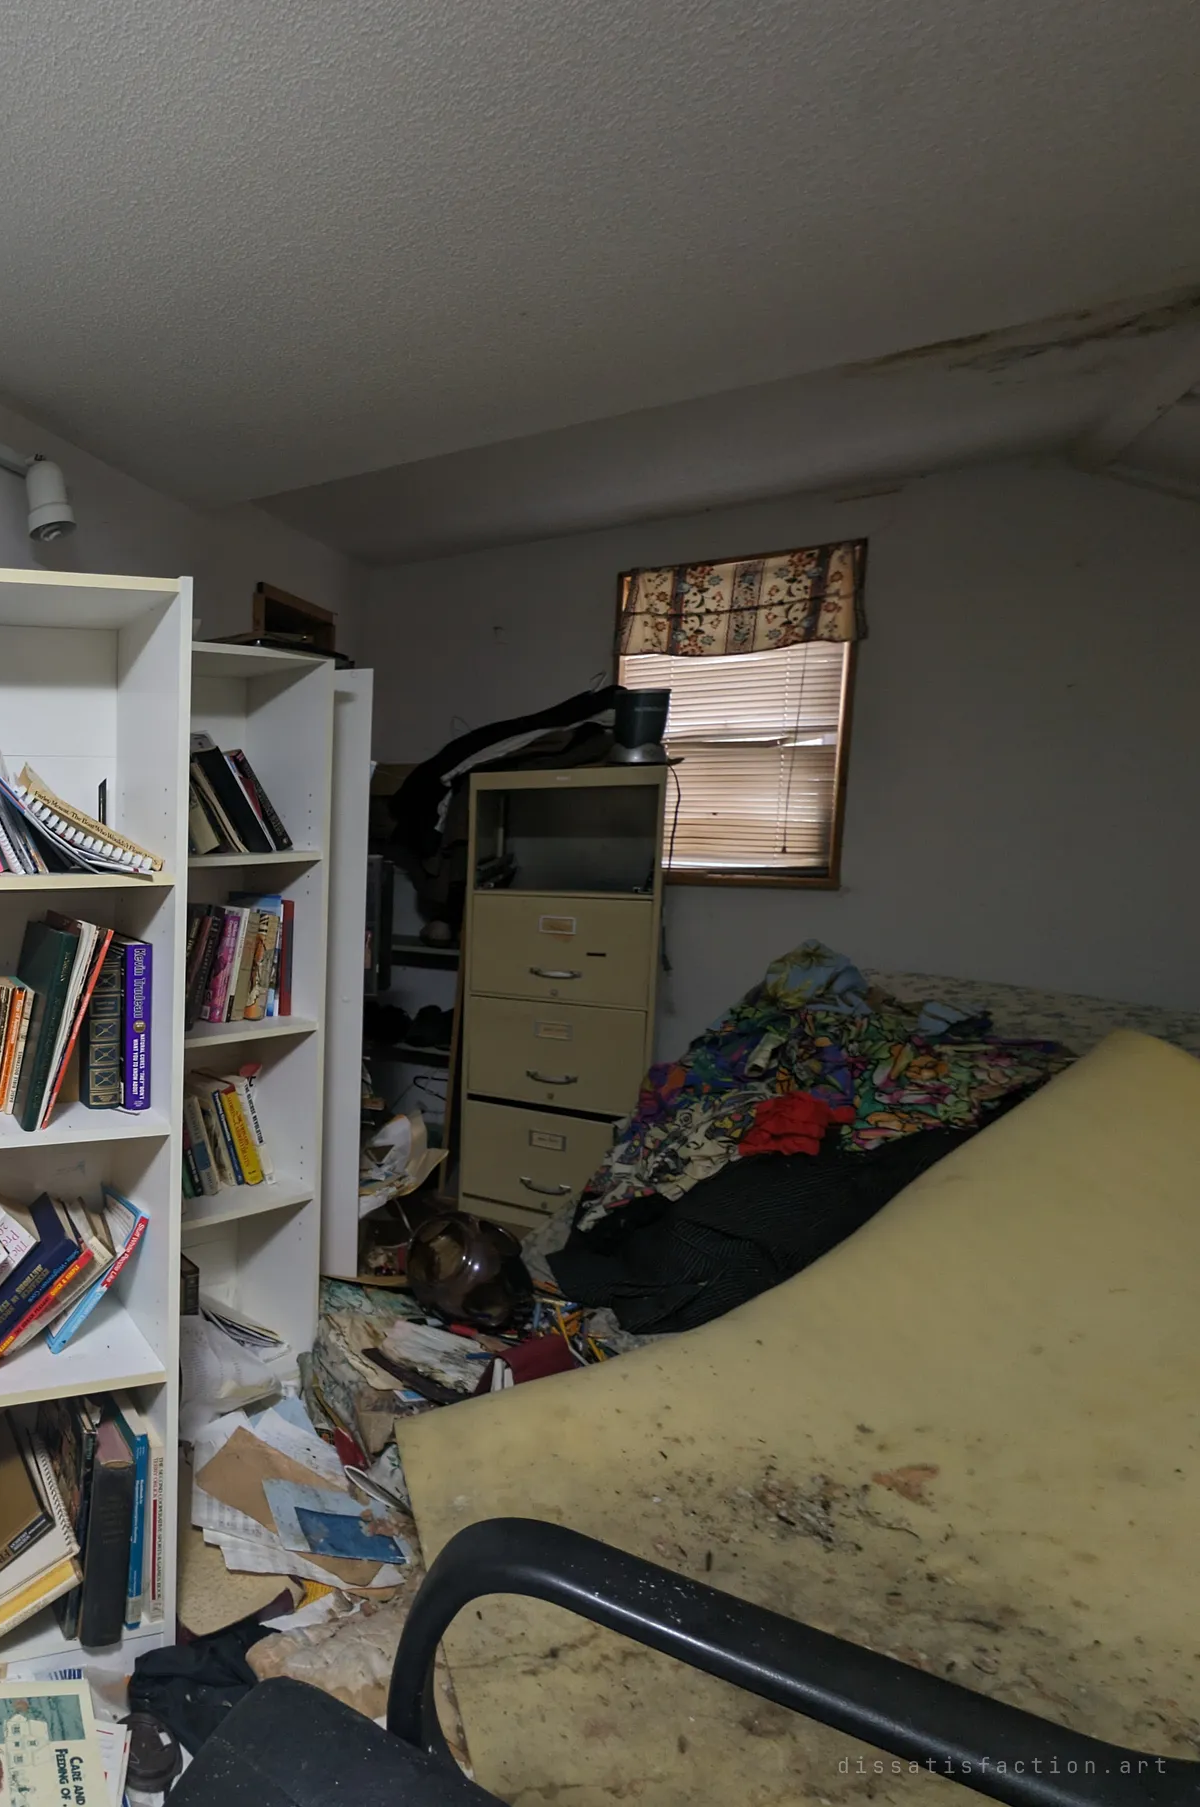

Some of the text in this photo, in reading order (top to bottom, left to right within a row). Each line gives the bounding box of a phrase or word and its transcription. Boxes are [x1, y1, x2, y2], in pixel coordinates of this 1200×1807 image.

[132, 947, 146, 1018] Kevin Trudeau
[245, 1093, 256, 1115] GLUCOSE
[251, 1114, 264, 1144] REVOLUTION
[10, 1238, 30, 1258] The
[105, 1221, 146, 1284] Stuff White People Like
[12, 1262, 45, 1295] METHODS
[53, 1746, 74, 1801] FEEDING OF
[67, 1754, 87, 1806] CARE AND
